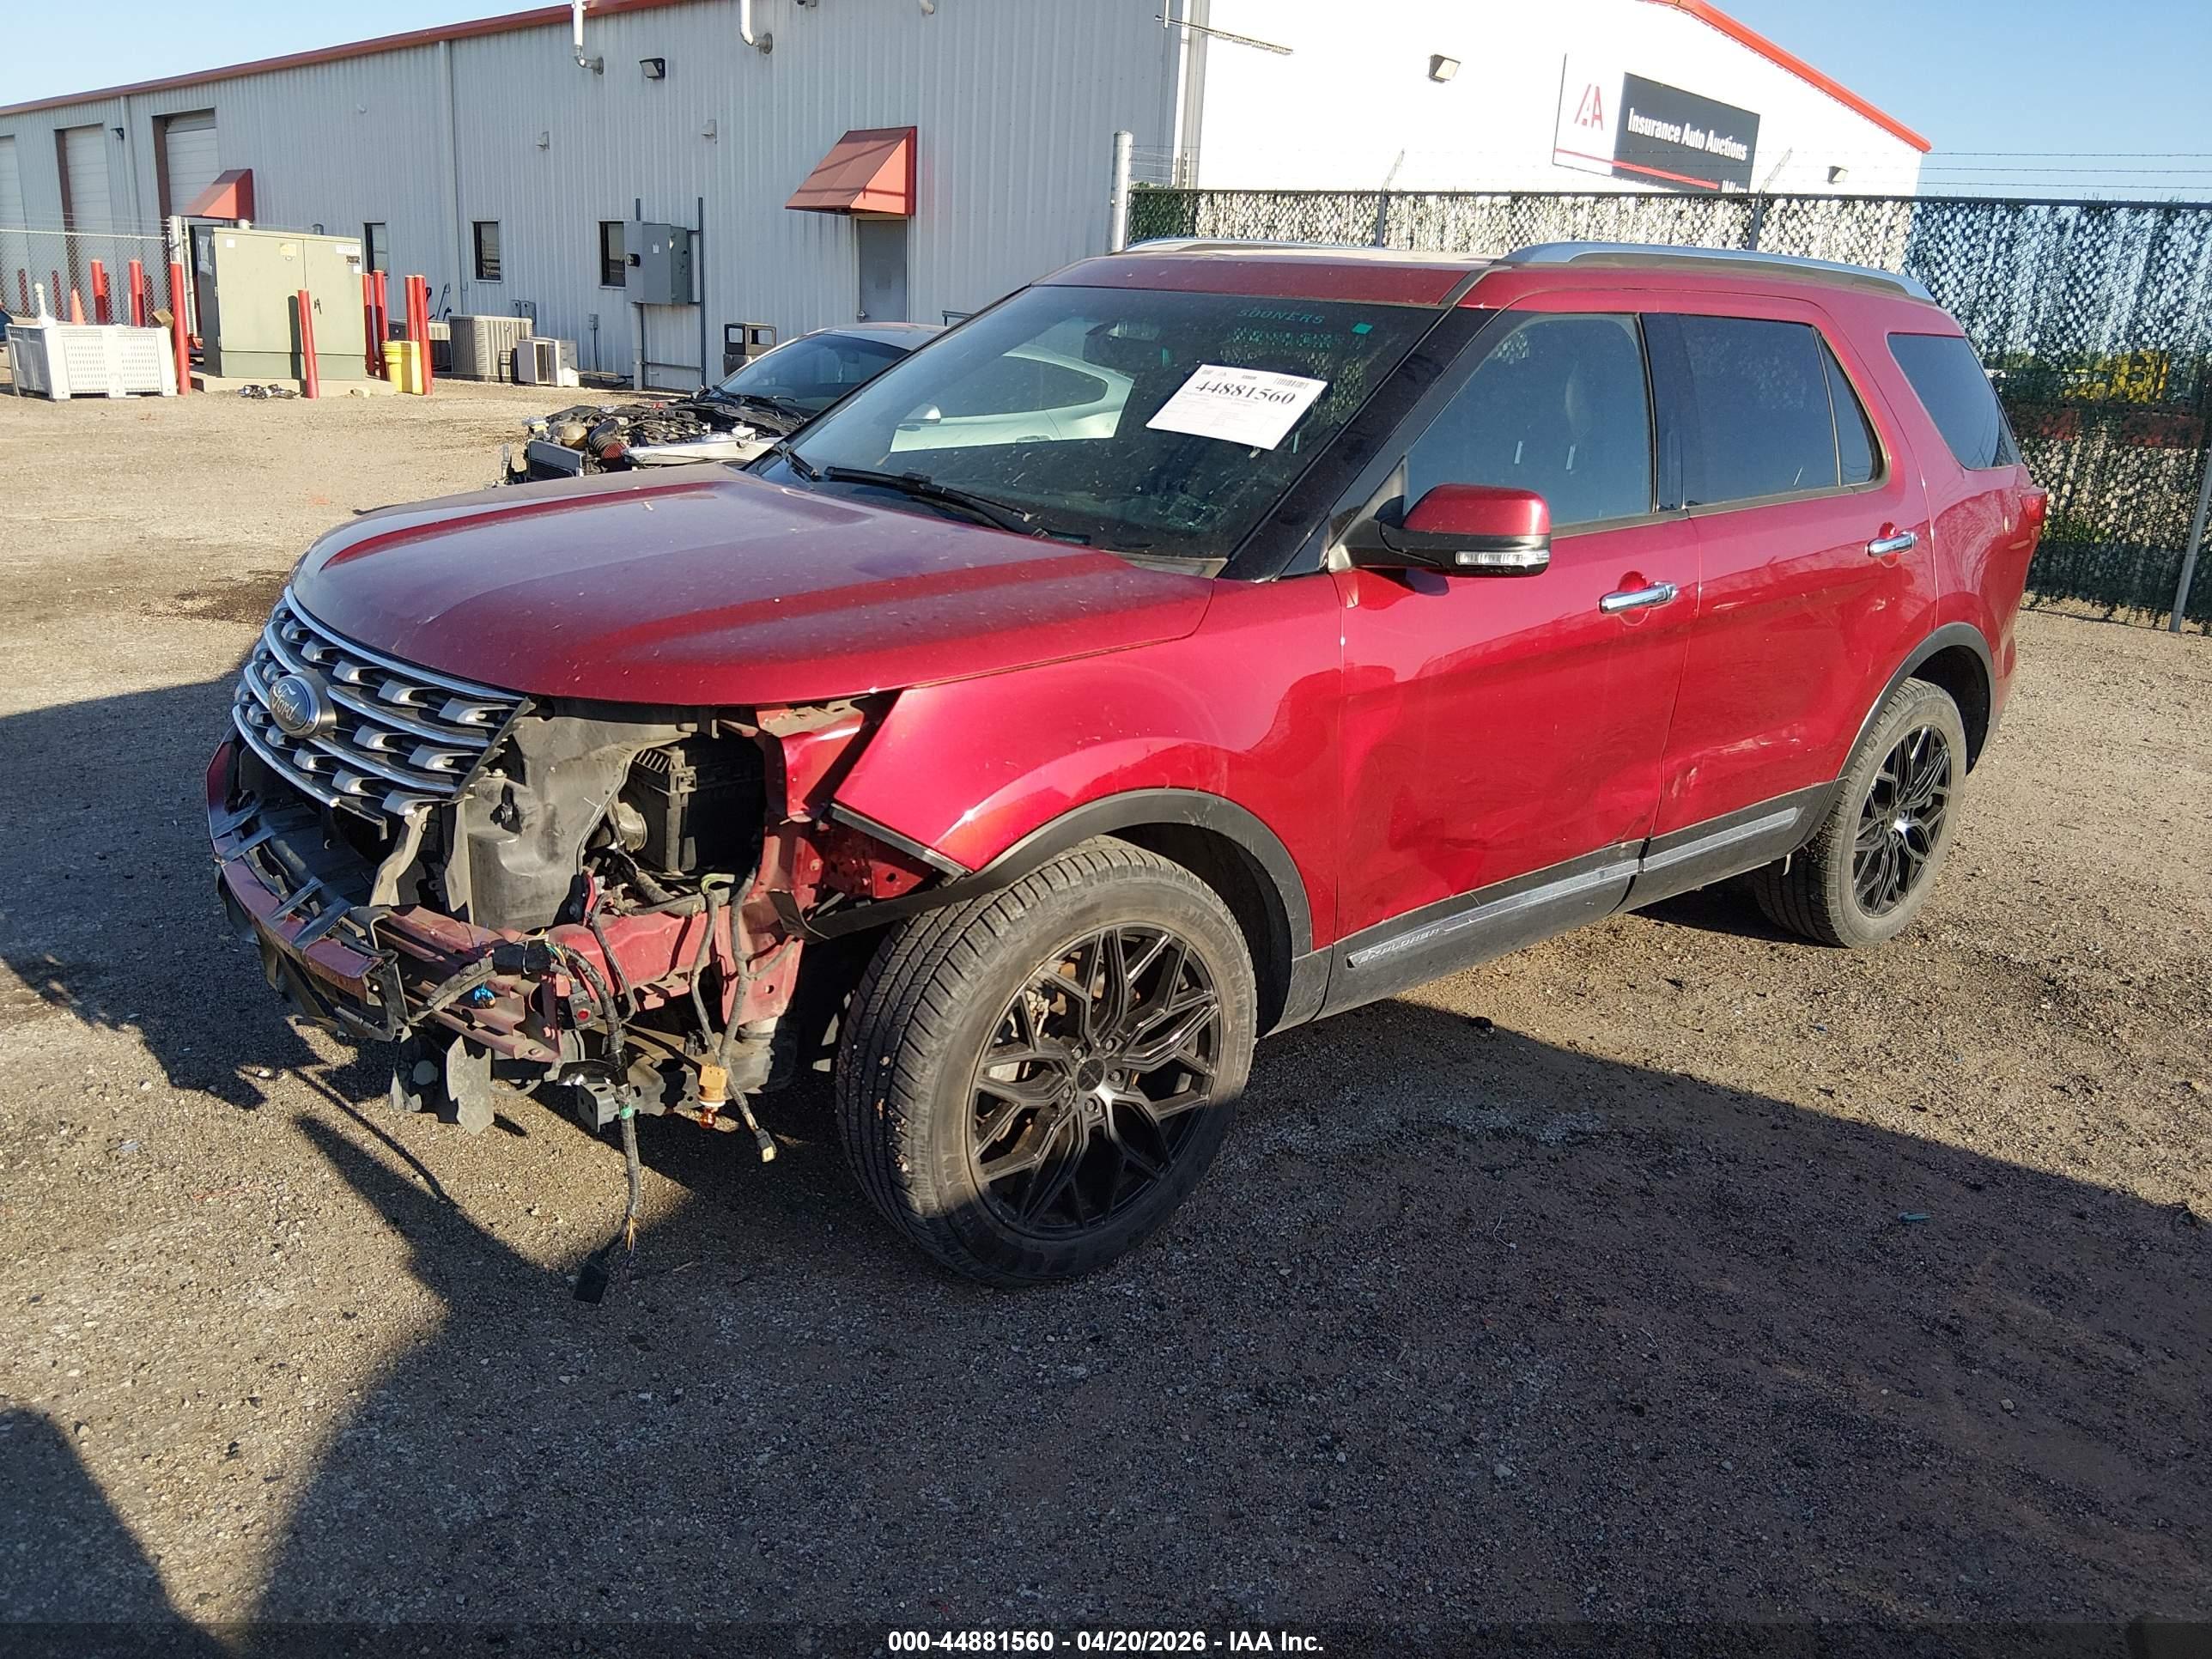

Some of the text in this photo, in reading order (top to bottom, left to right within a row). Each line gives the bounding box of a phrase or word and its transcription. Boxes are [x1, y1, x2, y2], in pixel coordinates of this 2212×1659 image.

[1627, 107, 1747, 161] Insurance Auto Auctions
[1237, 309, 1325, 324] SOONERS
[1194, 380, 1297, 405] 44881560
[271, 683, 300, 721] Ford
